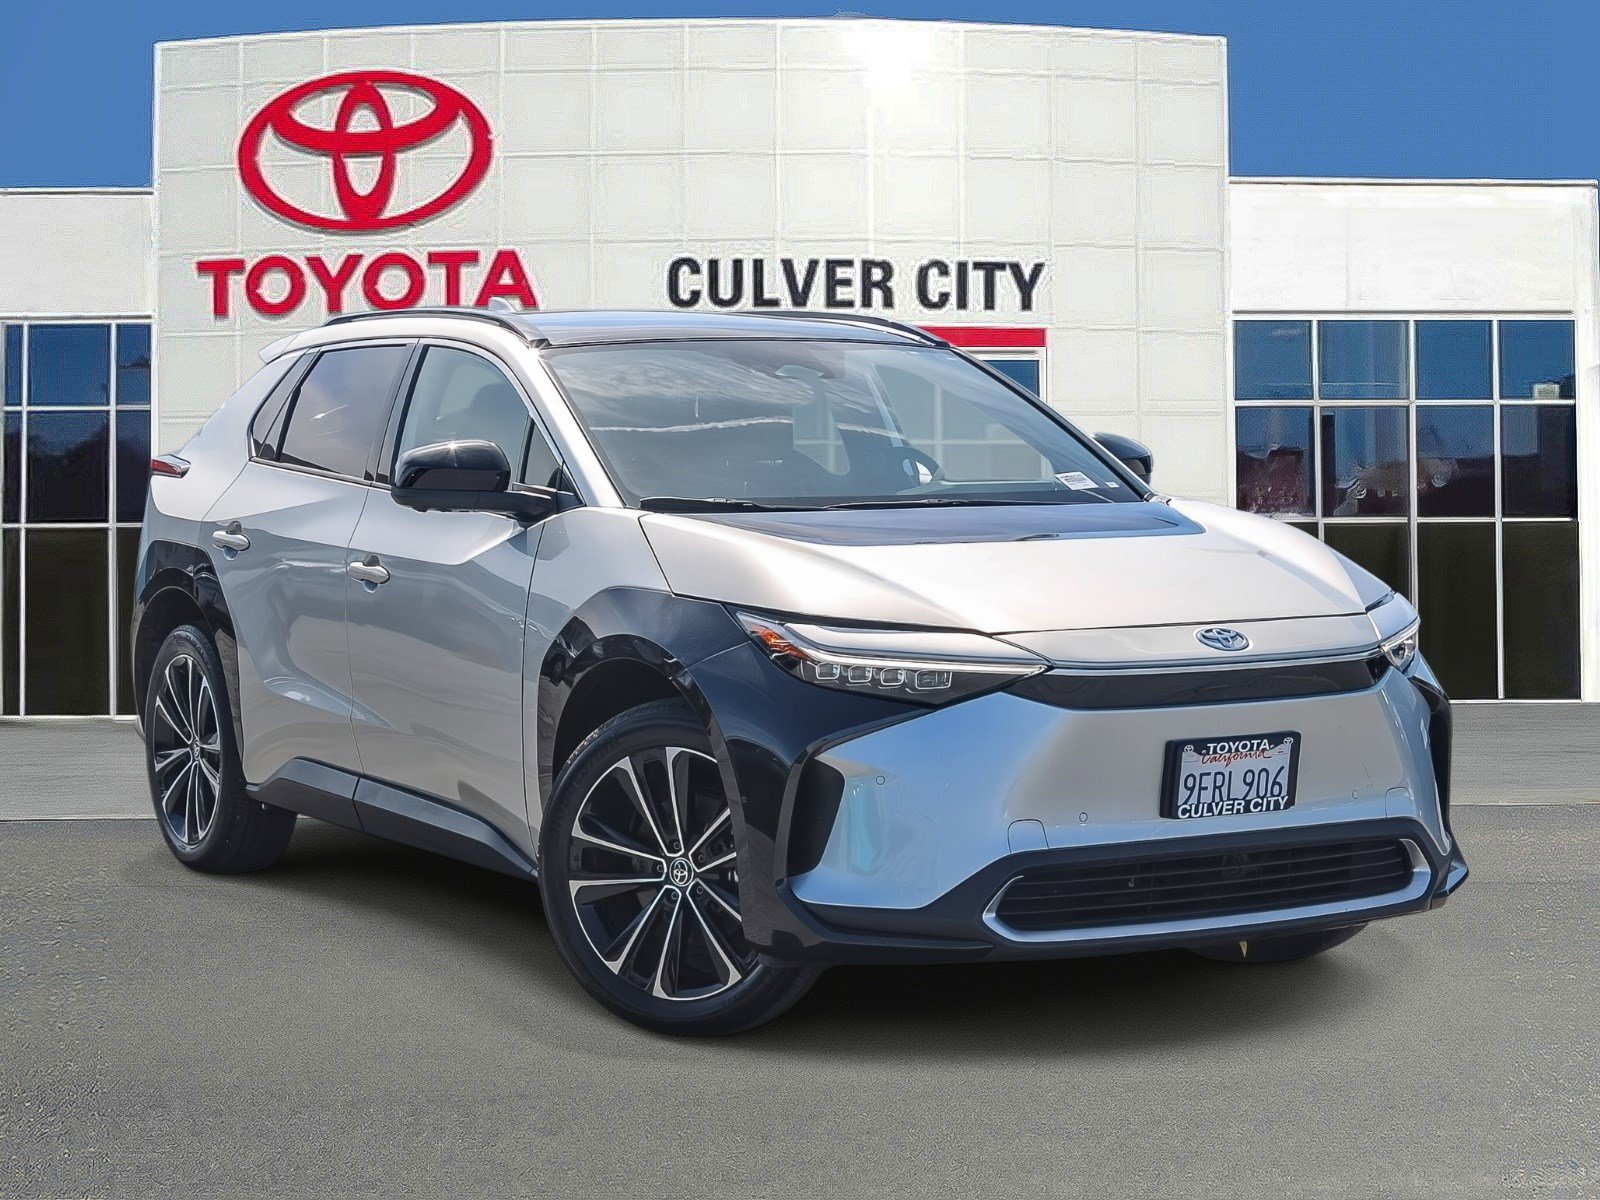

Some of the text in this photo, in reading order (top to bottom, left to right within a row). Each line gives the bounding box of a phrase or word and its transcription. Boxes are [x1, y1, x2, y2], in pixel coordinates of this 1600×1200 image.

[196, 249, 539, 317] TOYOTA
[667, 257, 1045, 311] CULVER CITY
[1207, 739, 1270, 754] TOYOTA
[1178, 795, 1289, 819] CULVER CITY
